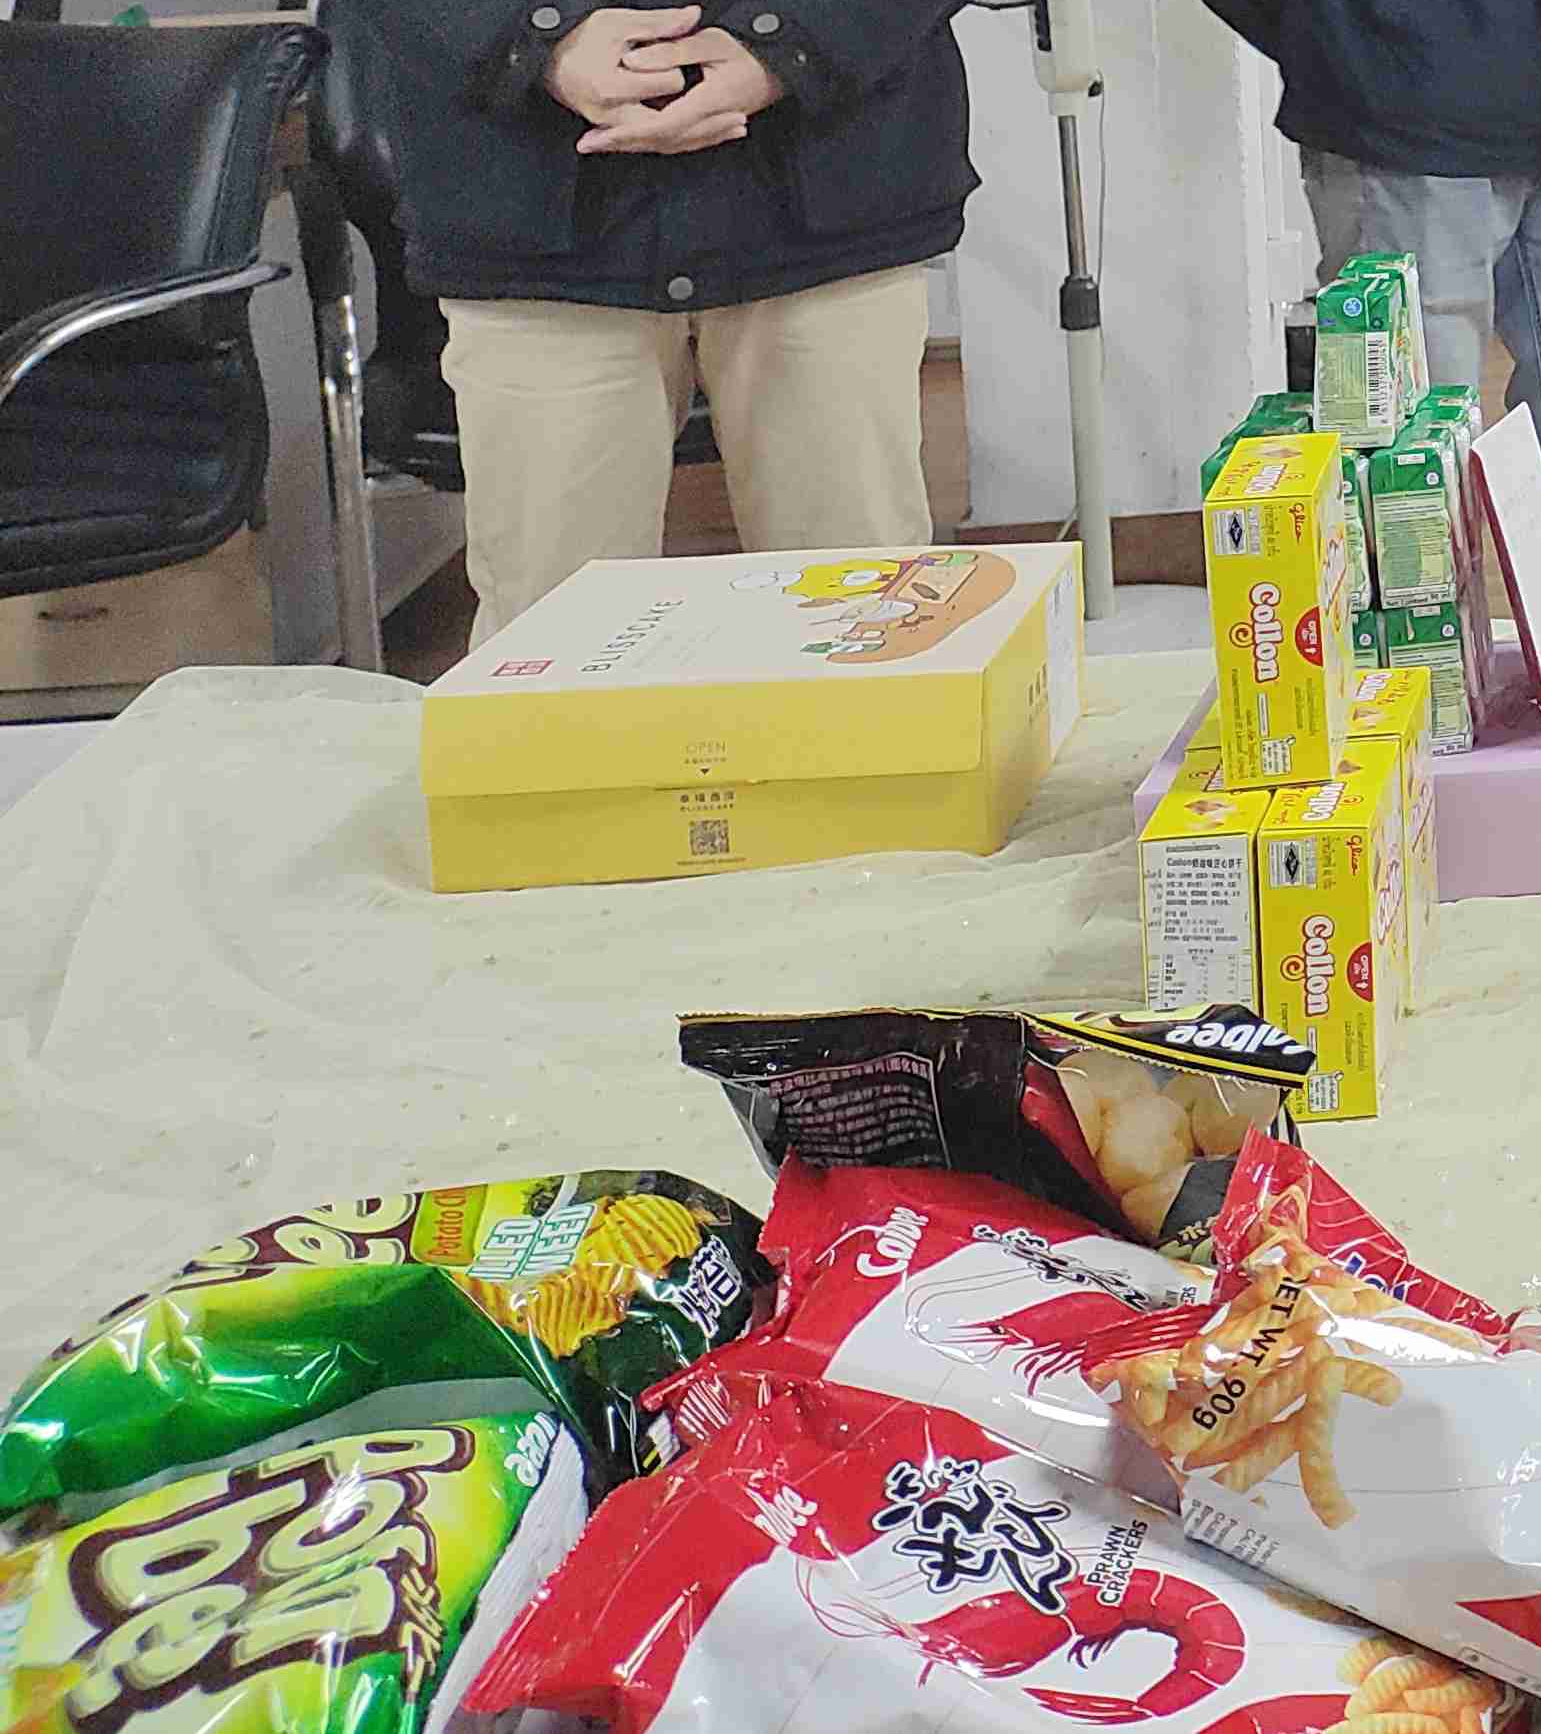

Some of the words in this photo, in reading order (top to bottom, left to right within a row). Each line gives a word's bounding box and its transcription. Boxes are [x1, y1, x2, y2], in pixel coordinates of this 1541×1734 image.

[1249, 581, 1284, 683] Collon
[1302, 914, 1337, 1018] Collon
[517, 1202, 598, 1277] WEED
[1191, 1376, 1247, 1430] 90g
[1086, 1524, 1129, 1586] PRAWN
[1098, 1518, 1149, 1606] CRACKERS
